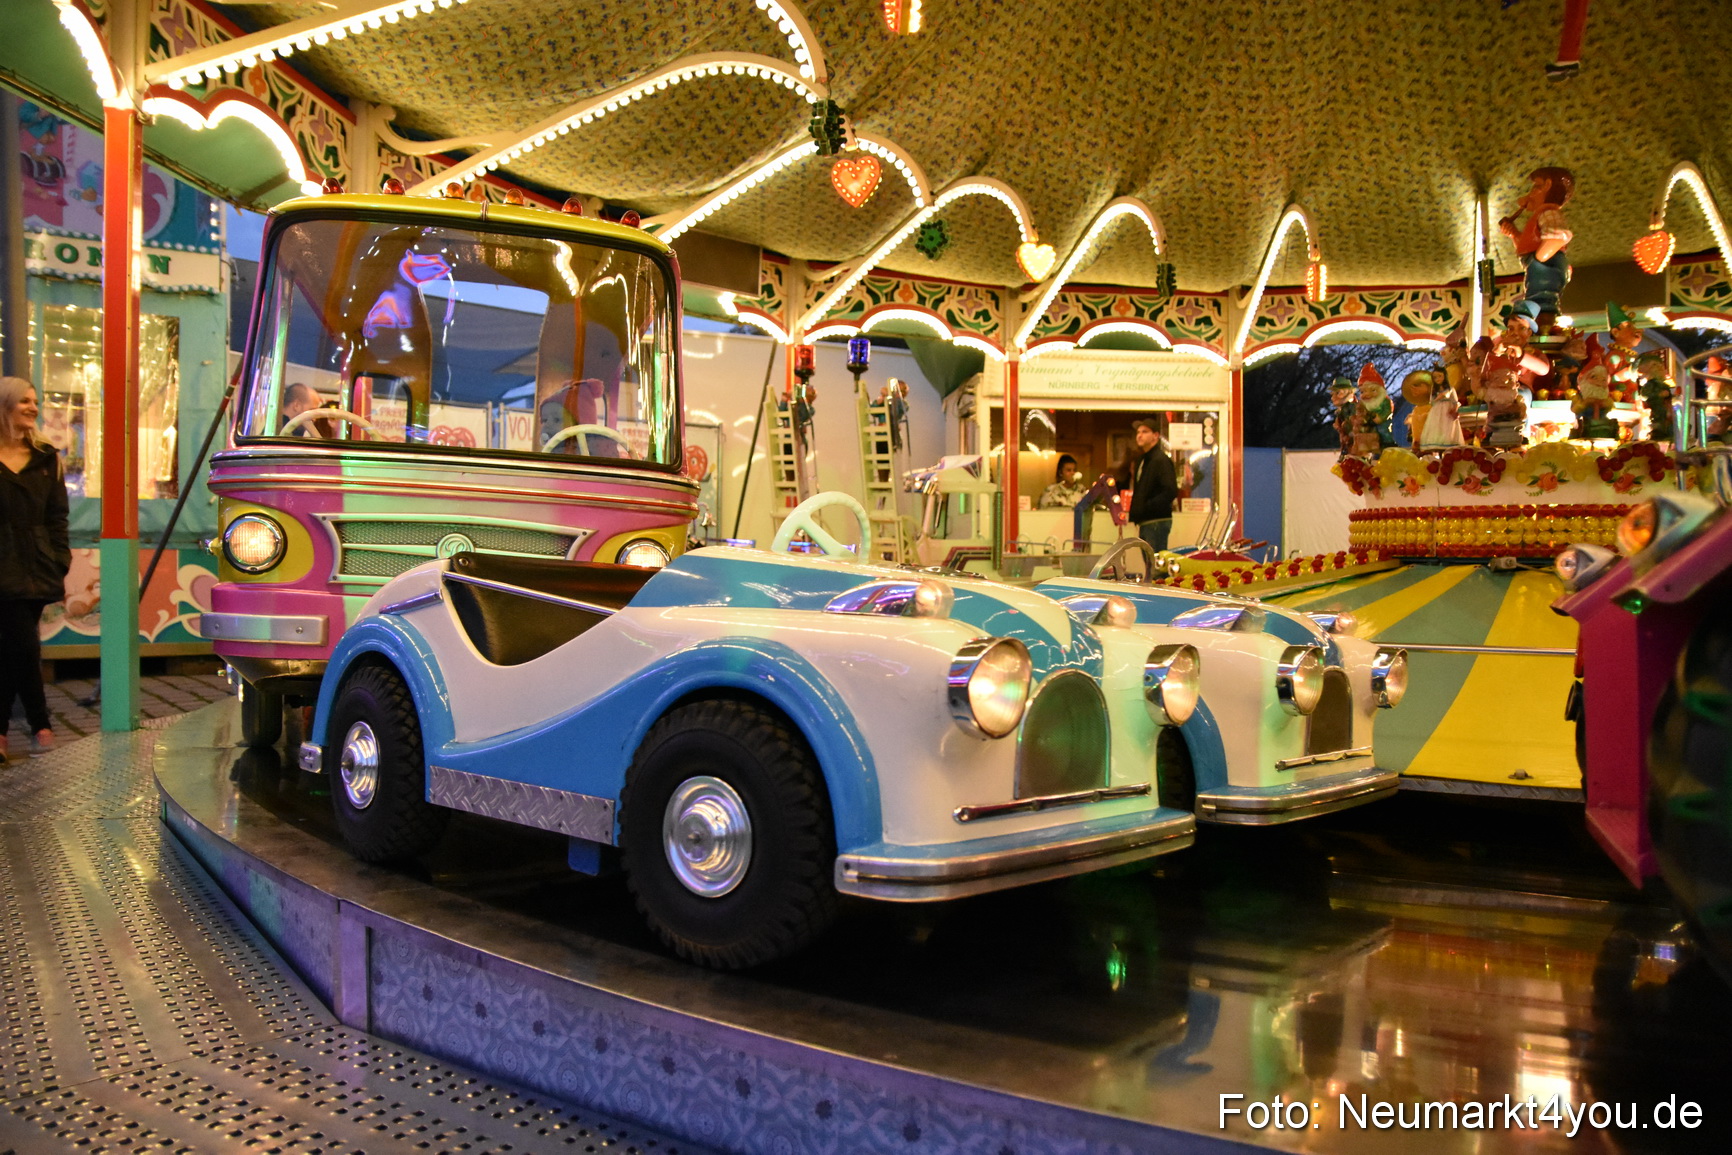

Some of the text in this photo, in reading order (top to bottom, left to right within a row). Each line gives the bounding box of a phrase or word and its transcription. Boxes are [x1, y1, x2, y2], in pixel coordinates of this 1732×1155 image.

[1094, 364, 1215, 381] Vergnügungsbetriebe
[1048, 380, 1100, 389] NÜRNBERG
[1112, 382, 1170, 392] HERSBRUCK
